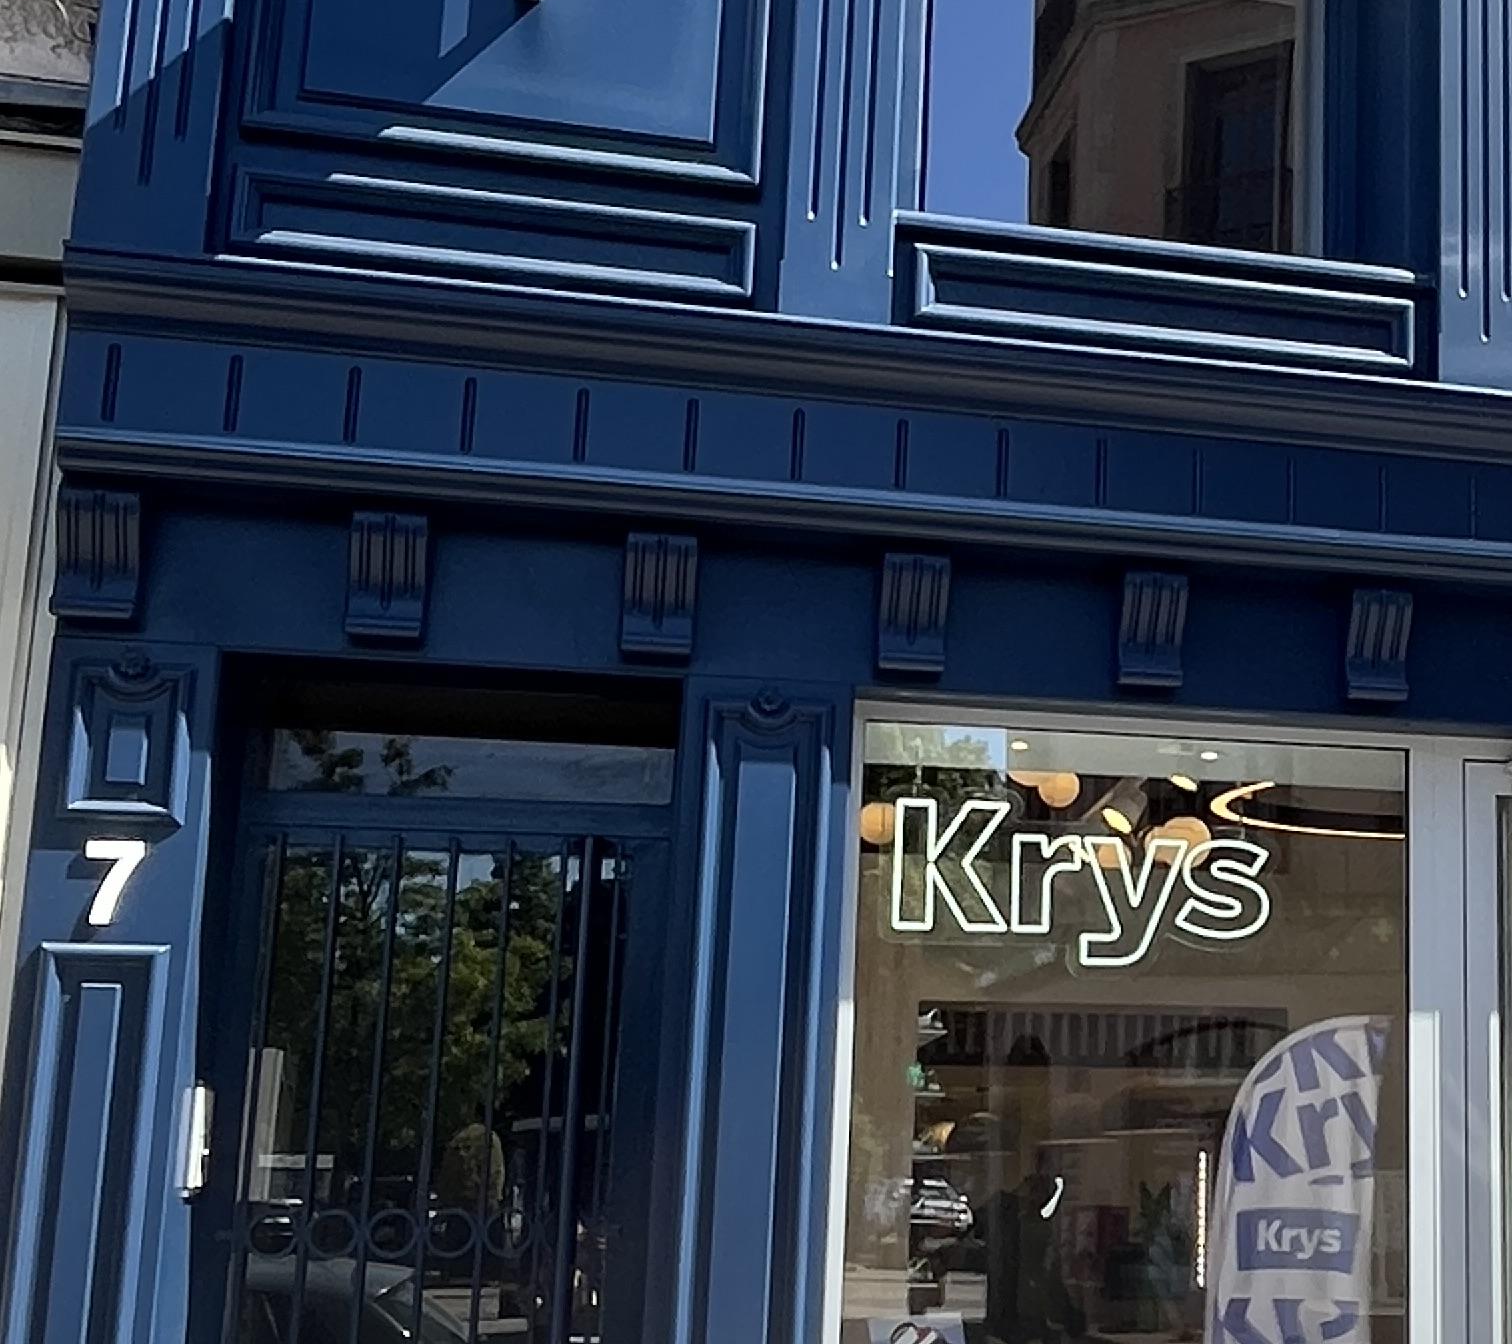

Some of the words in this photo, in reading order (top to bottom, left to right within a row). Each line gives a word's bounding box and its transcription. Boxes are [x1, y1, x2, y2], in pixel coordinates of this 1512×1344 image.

[85, 840, 146, 925] 7
[891, 798, 1270, 966] Krys
[1256, 1218, 1343, 1260] Krys
